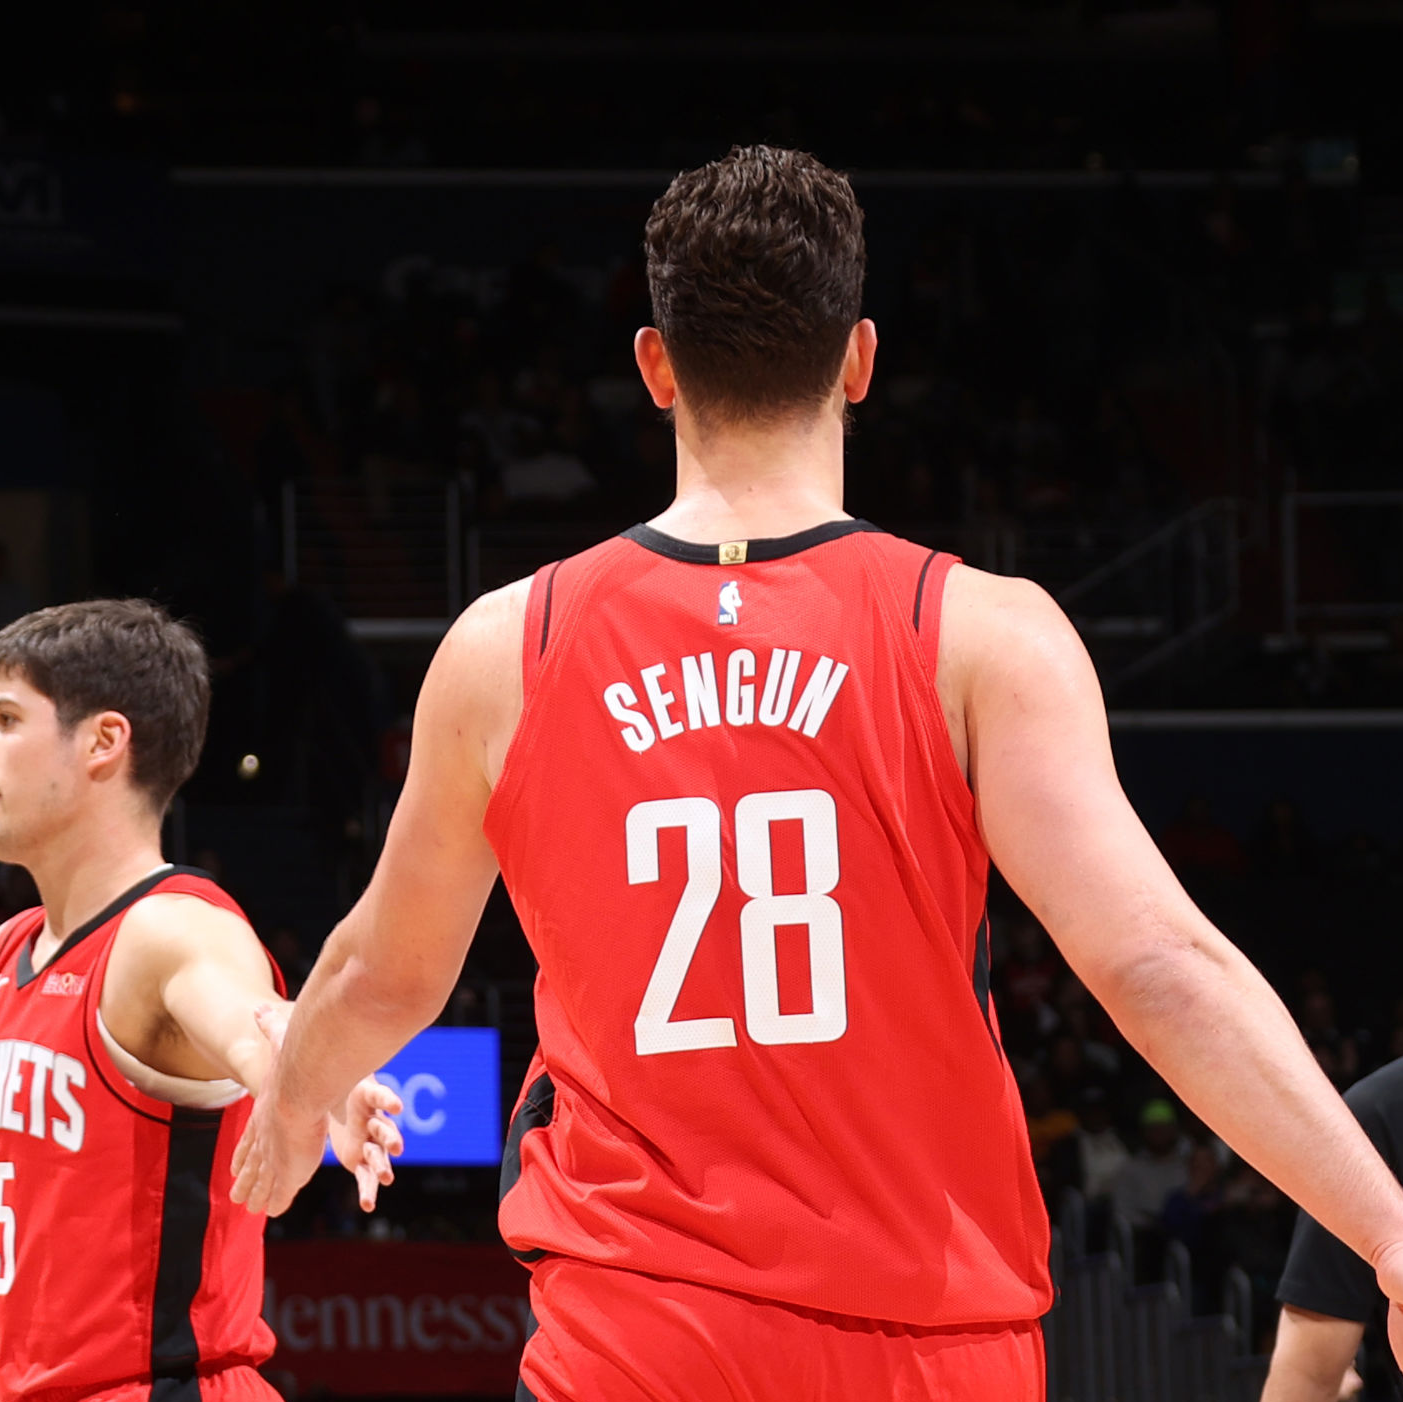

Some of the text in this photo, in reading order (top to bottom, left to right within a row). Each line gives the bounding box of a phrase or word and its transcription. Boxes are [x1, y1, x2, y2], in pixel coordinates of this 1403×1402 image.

[603, 647, 850, 755] SENGUN
[625, 788, 848, 1056] 28
[266, 1278, 528, 1354] enness
